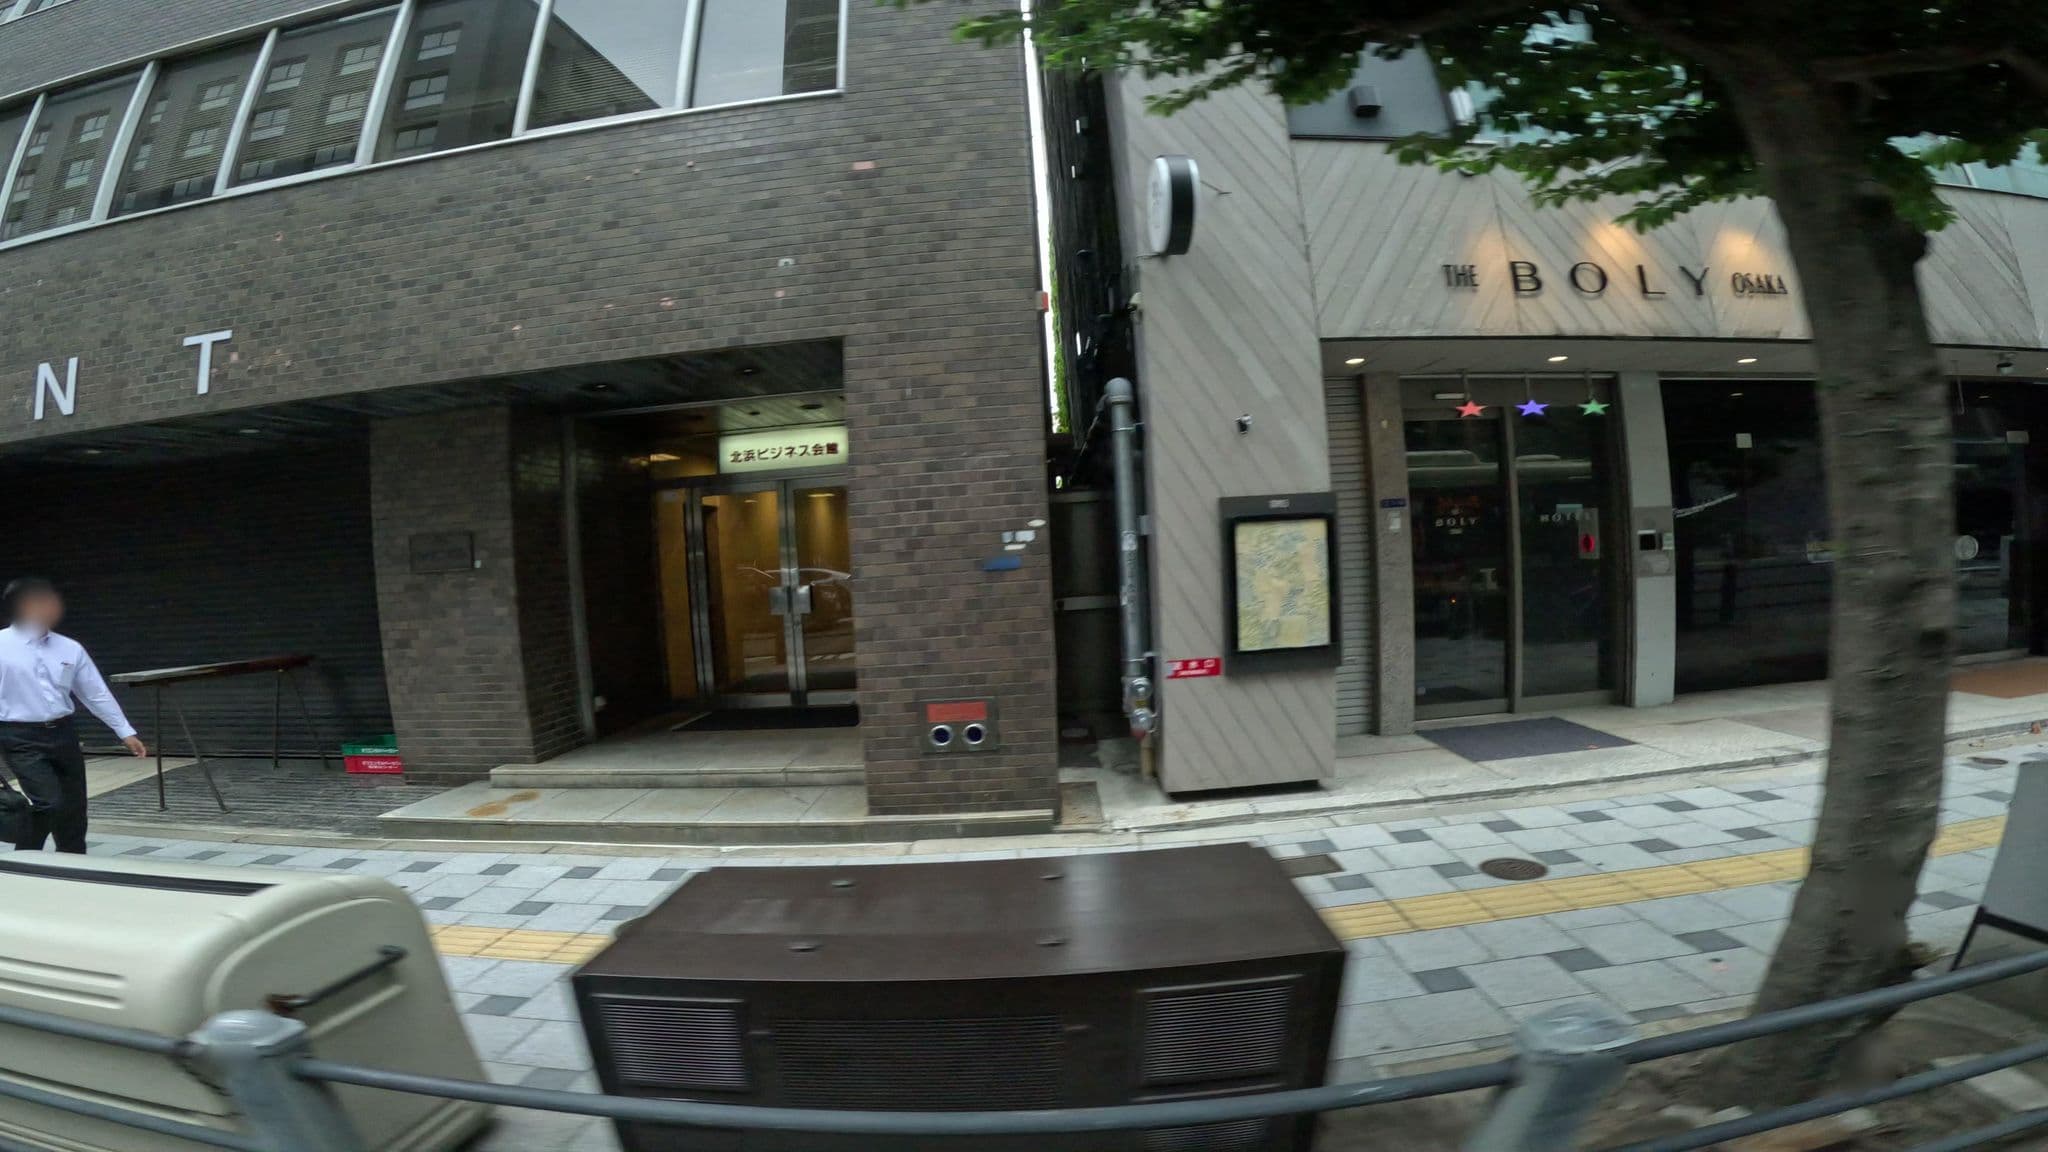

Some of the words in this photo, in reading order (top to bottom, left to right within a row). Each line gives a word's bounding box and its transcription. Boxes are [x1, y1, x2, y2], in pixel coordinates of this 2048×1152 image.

[1441, 264, 1479, 289] THE
[1509, 260, 1710, 296] BOLY
[1731, 272, 1788, 295] OSAKA
